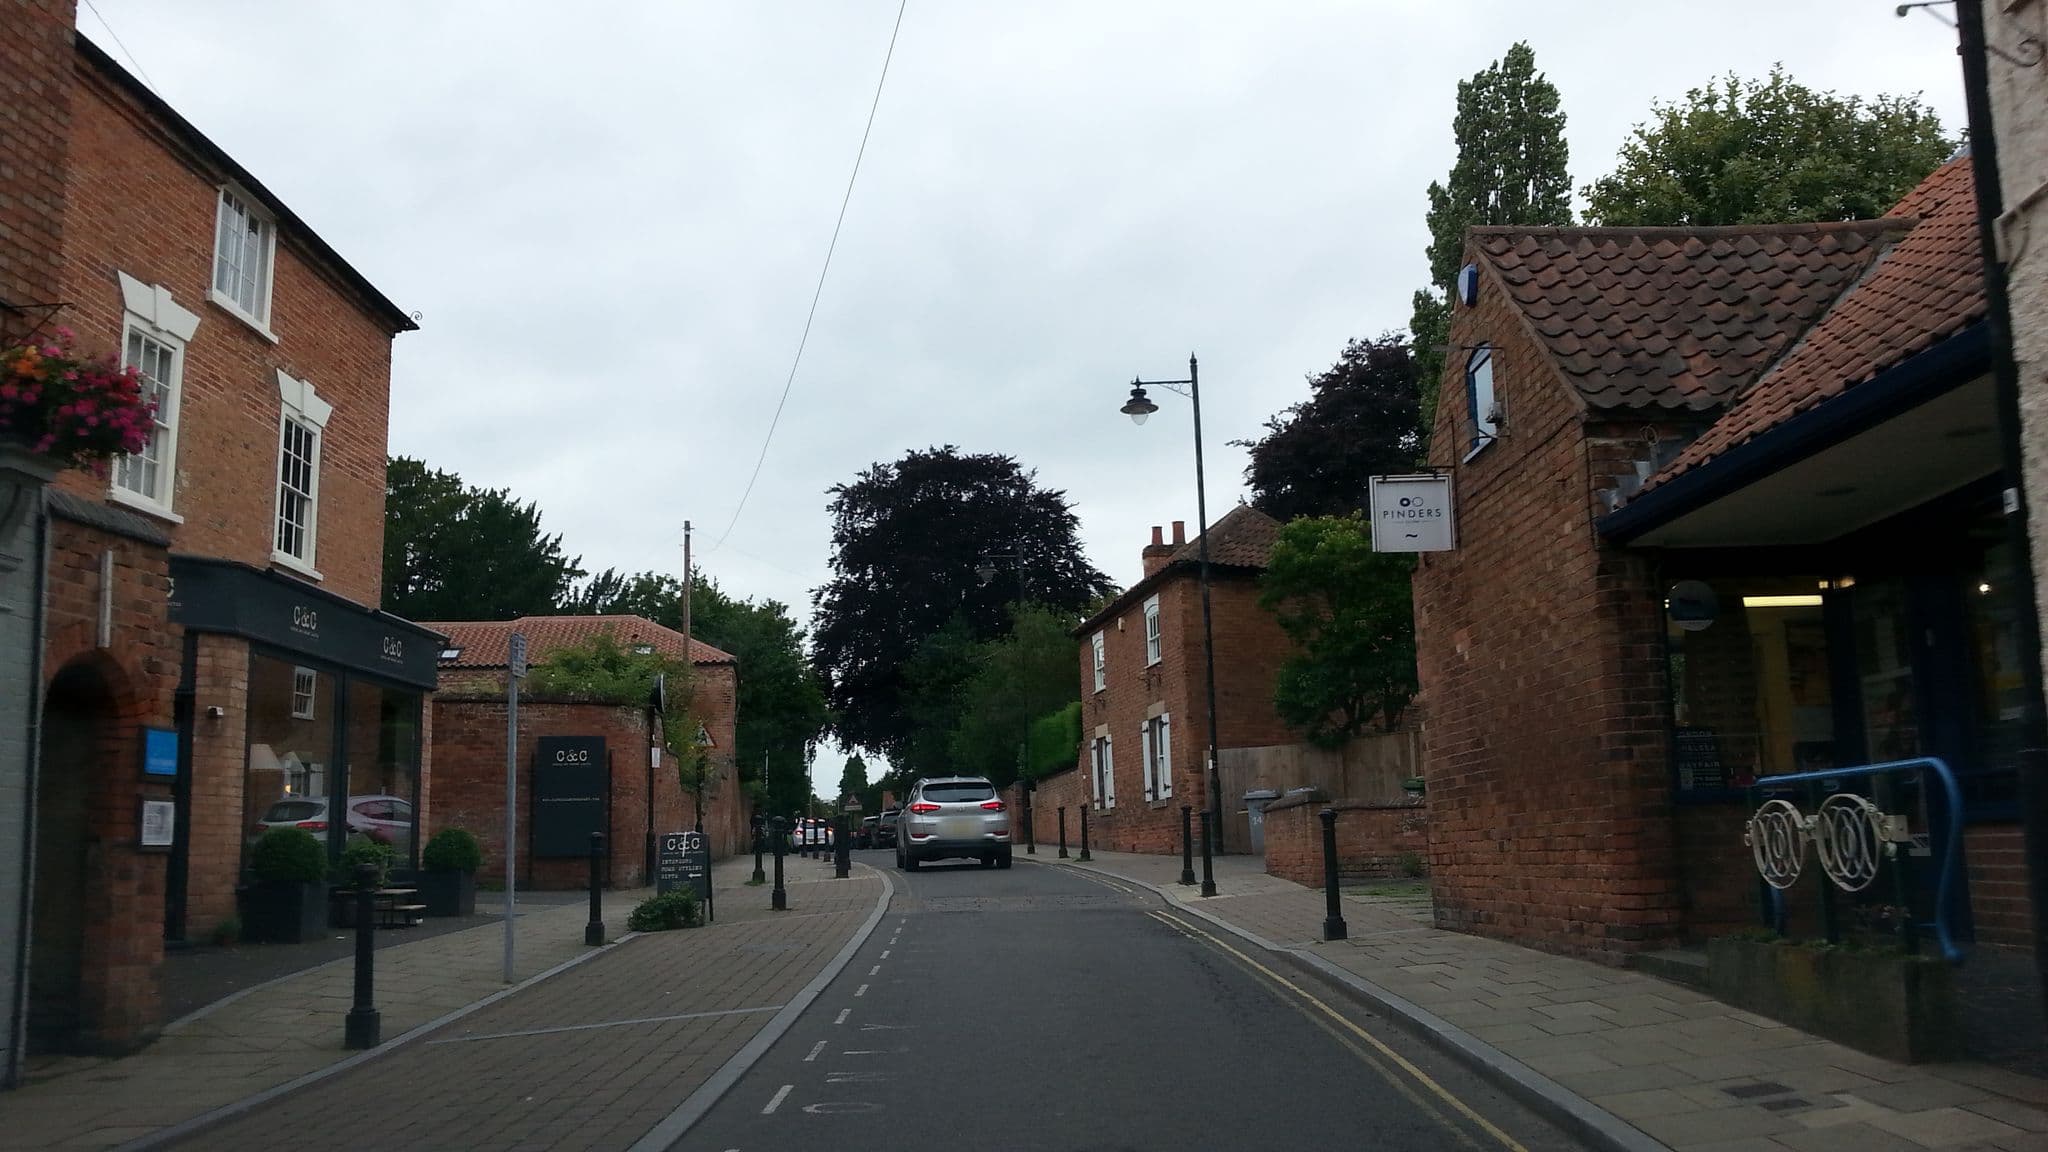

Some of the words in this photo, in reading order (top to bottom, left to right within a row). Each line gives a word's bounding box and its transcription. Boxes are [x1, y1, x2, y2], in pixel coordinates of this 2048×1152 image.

[1382, 508, 1442, 519] PINDERS
[293, 606, 317, 630] C&C
[383, 636, 402, 657] C&C
[556, 749, 588, 762] C&C
